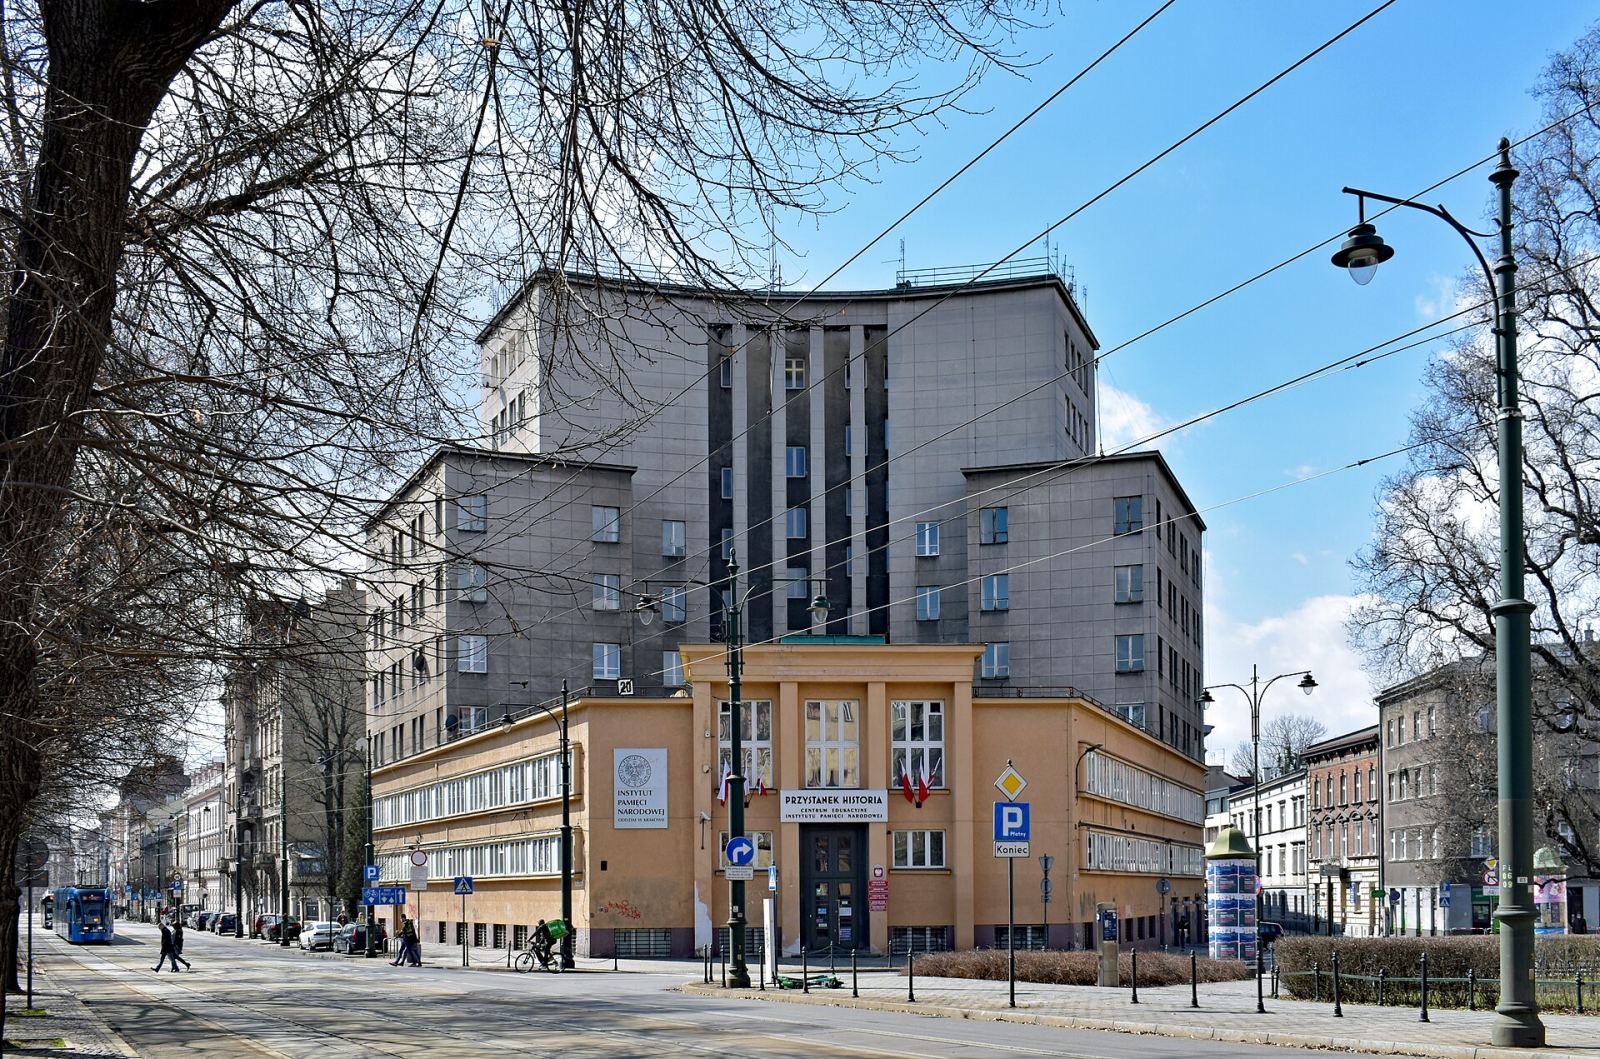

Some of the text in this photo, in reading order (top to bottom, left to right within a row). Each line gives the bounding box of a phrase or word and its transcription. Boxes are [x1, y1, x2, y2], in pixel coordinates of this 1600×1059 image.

[620, 680, 631, 693] 20
[617, 799, 647, 807] PAMIĘCI
[785, 796, 882, 804] PRZYSTANEK HISTORIA
[617, 808, 665, 816] NARODOWEJ
[1002, 806, 1023, 836] P
[996, 845, 1028, 854] Koniec
[367, 867, 377, 879] P
[1502, 872, 1513, 880] 06
[1502, 880, 1513, 889] 09
